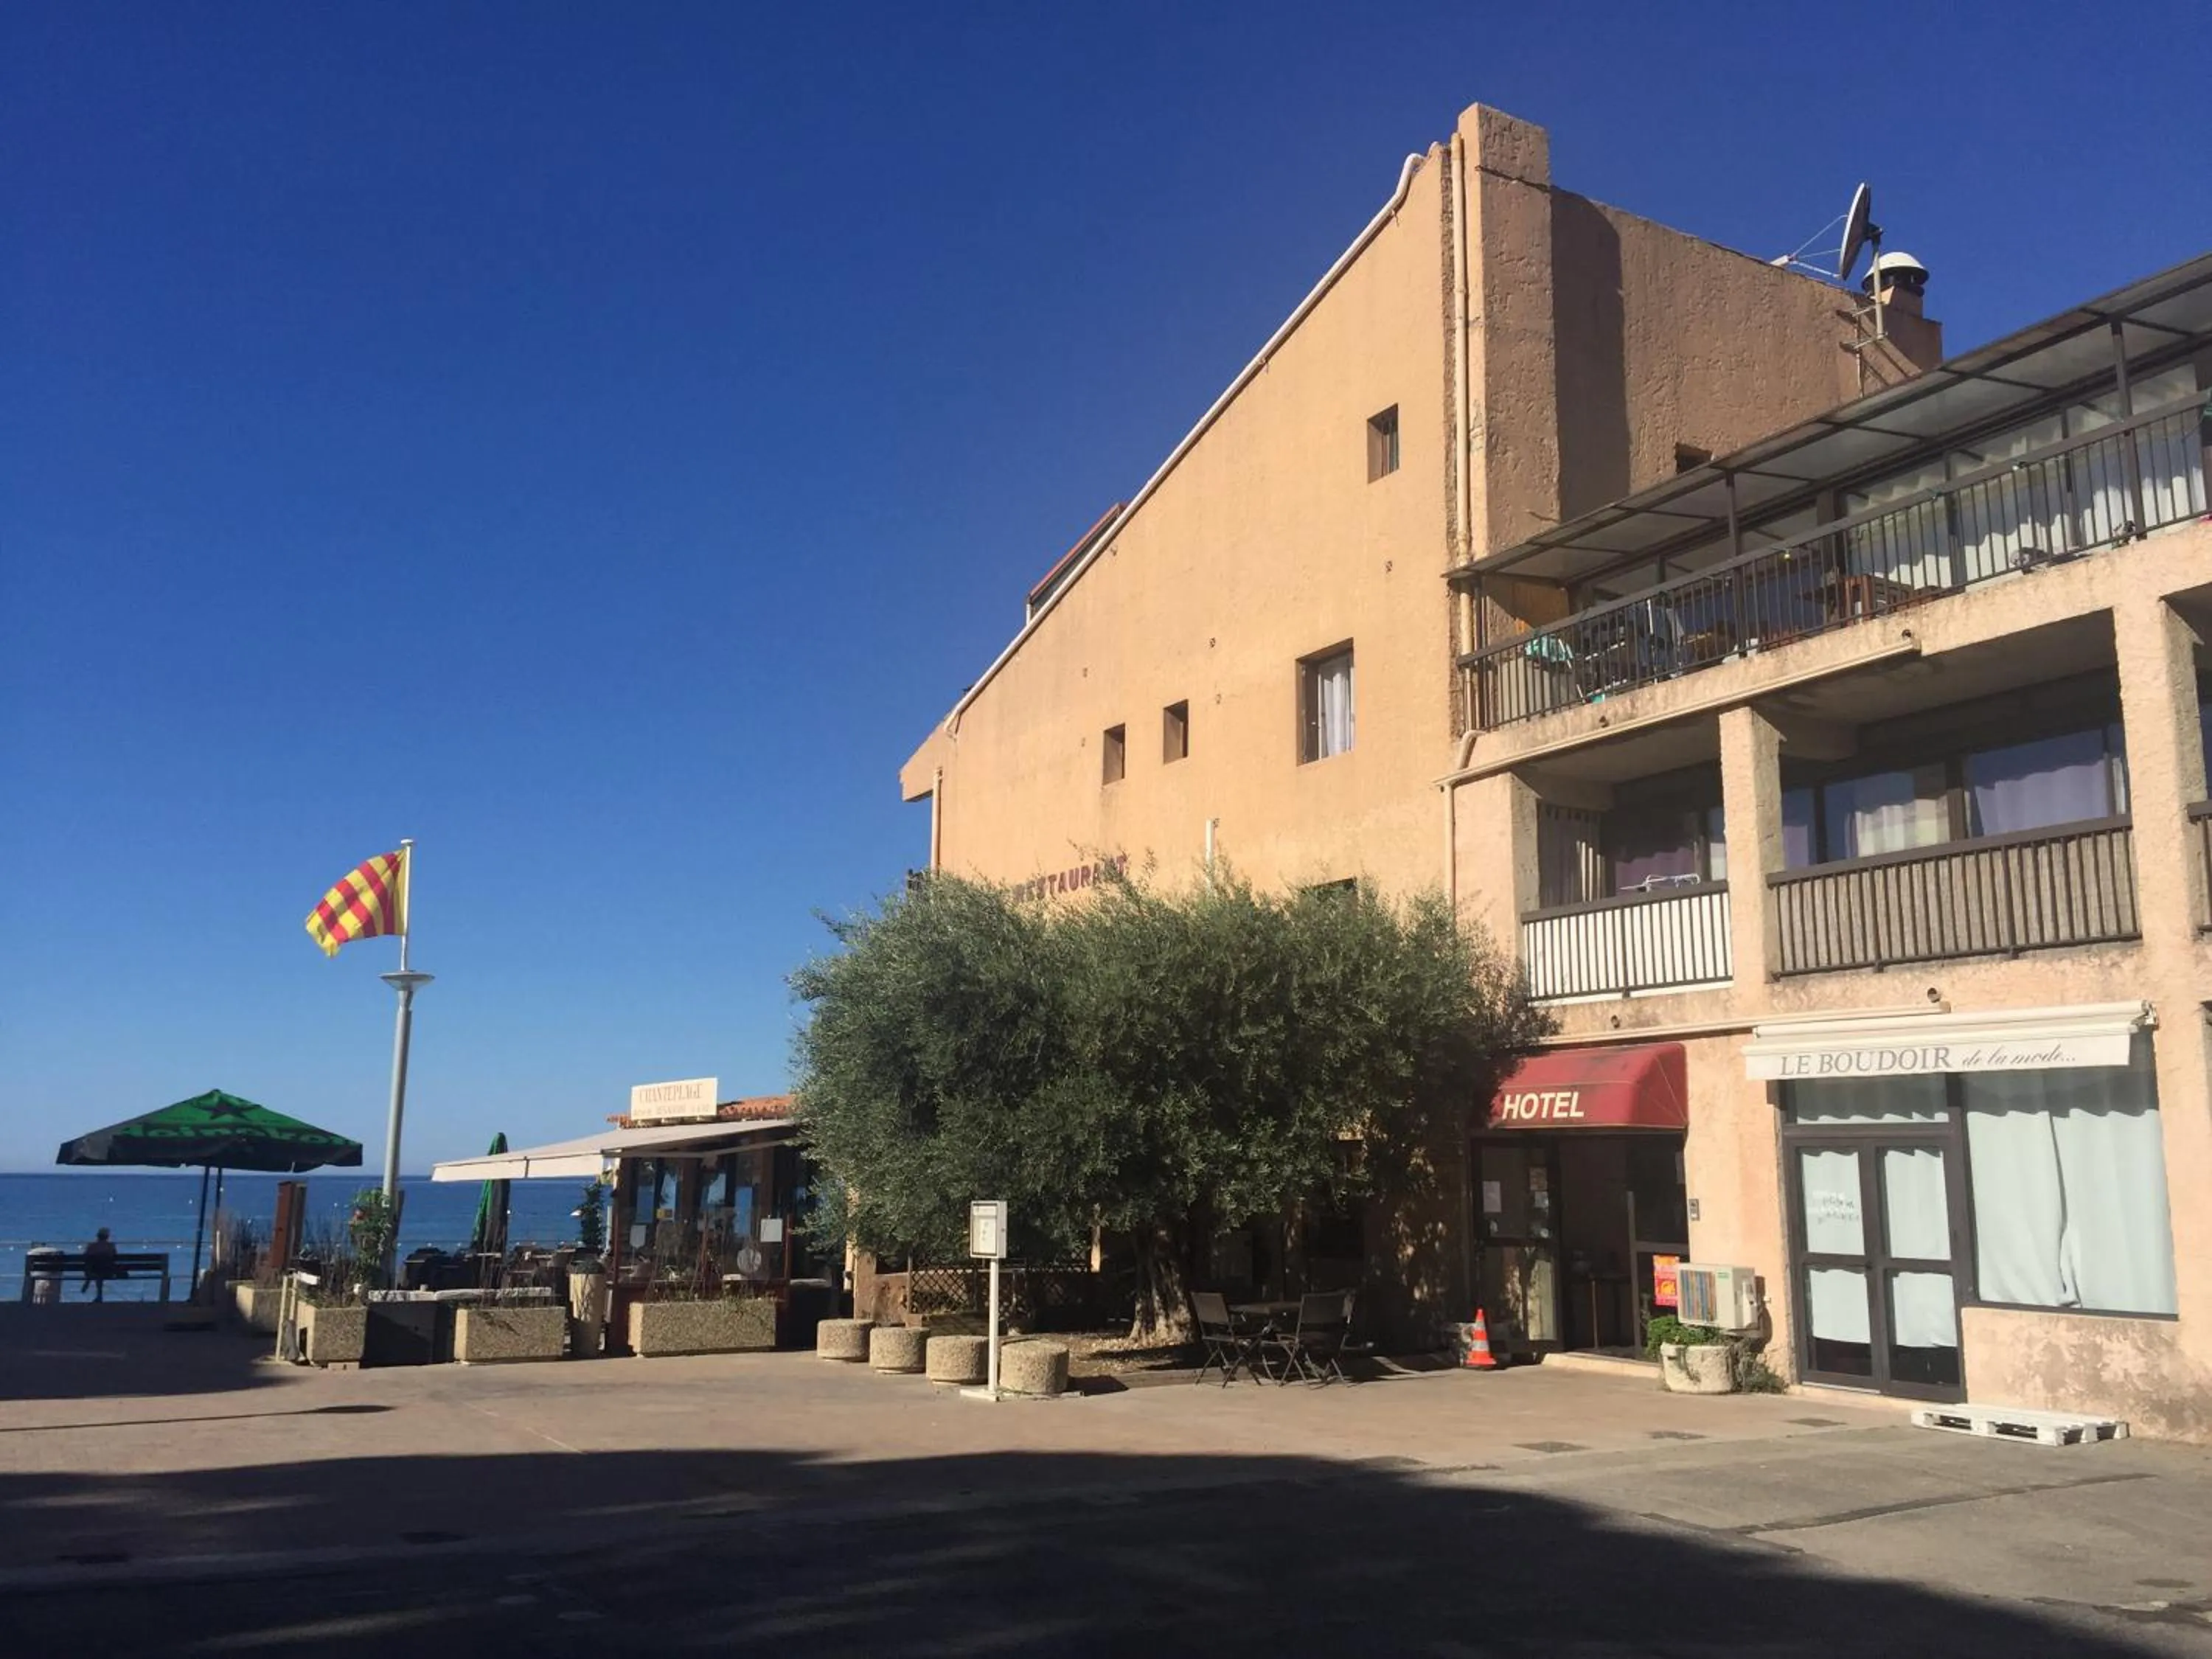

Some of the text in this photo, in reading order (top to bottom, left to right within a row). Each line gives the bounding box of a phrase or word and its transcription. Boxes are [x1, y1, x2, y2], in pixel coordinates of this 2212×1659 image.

[1780, 1054, 1811, 1076] LE
[1818, 1046, 1952, 1074] BOUDOIR
[1962, 1049, 1981, 1066] de
[1987, 1044, 2006, 1065] la
[1501, 1091, 1585, 1120] HOTEL
